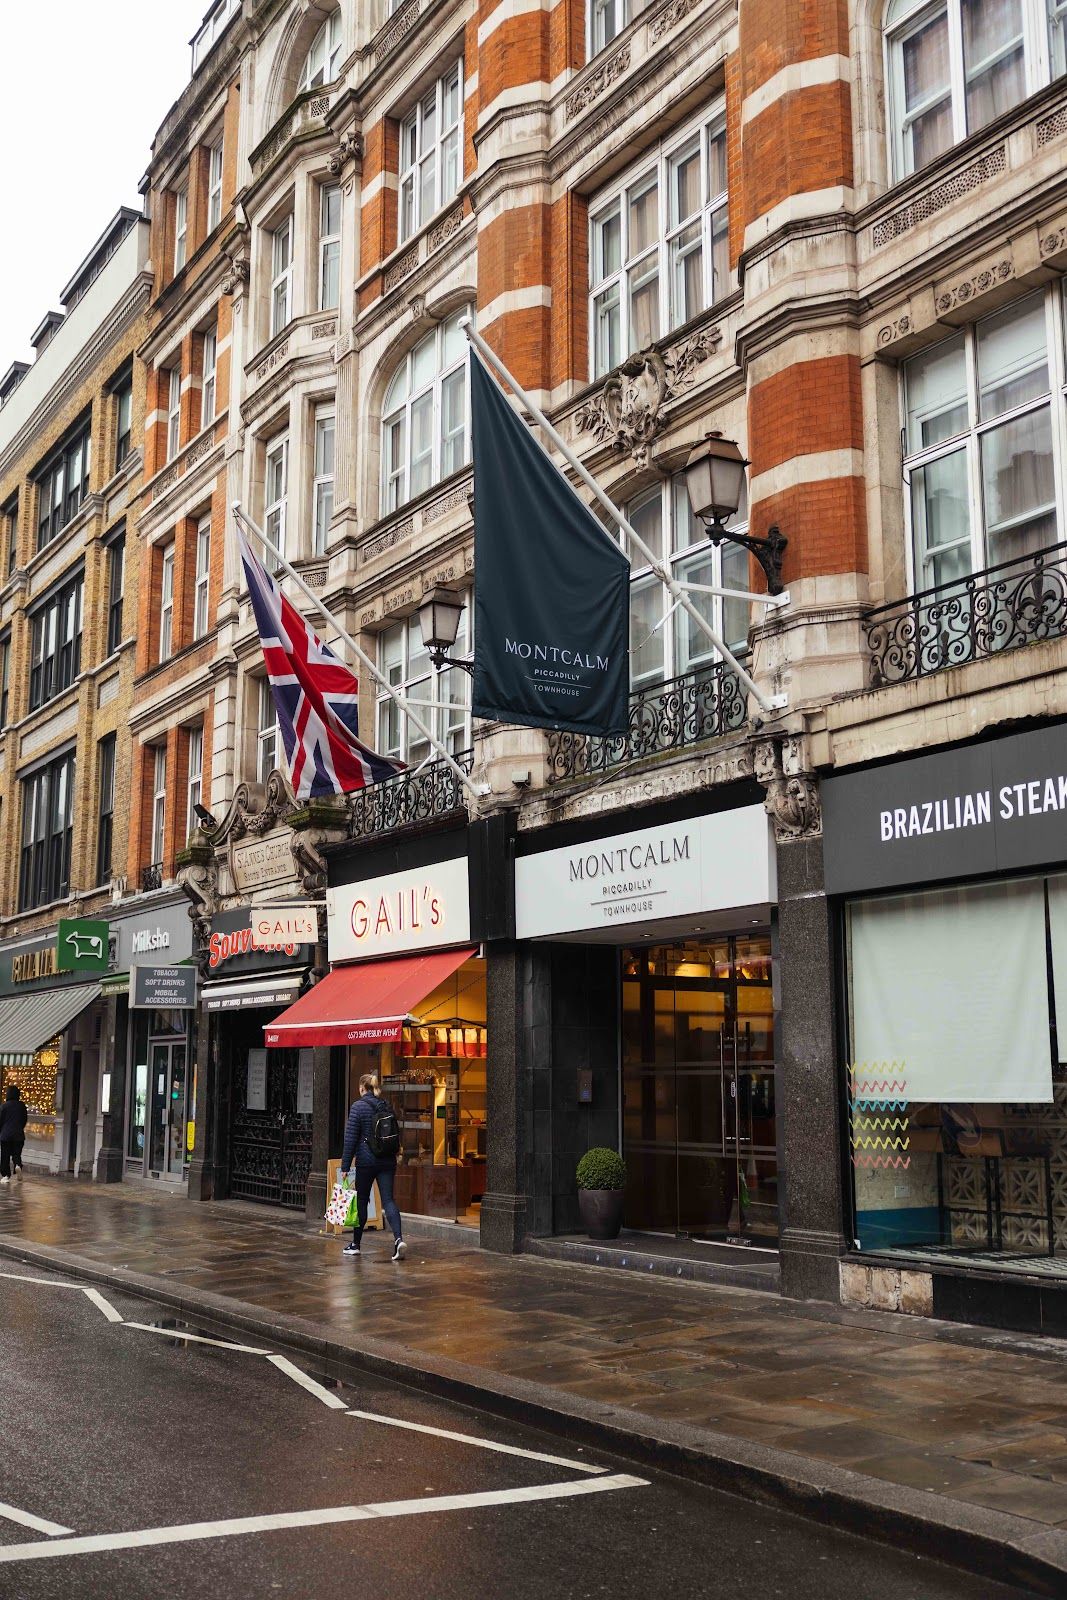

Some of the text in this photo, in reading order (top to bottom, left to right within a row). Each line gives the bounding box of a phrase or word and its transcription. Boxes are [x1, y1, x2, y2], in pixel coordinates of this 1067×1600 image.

[505, 637, 609, 671] MONTCALM
[534, 668, 580, 681] PICCADILLY
[533, 684, 580, 697] TOWNHOUSE
[880, 774, 1067, 842] BRAZILIAN STEAK
[265, 841, 291, 861] CHURCH
[568, 835, 691, 883] MONTCALM
[602, 878, 653, 896] PICCADILLY
[603, 900, 653, 917] TOWNHOUSE
[131, 928, 170, 953] Milksha
[153, 969, 179, 977] TOBACCO
